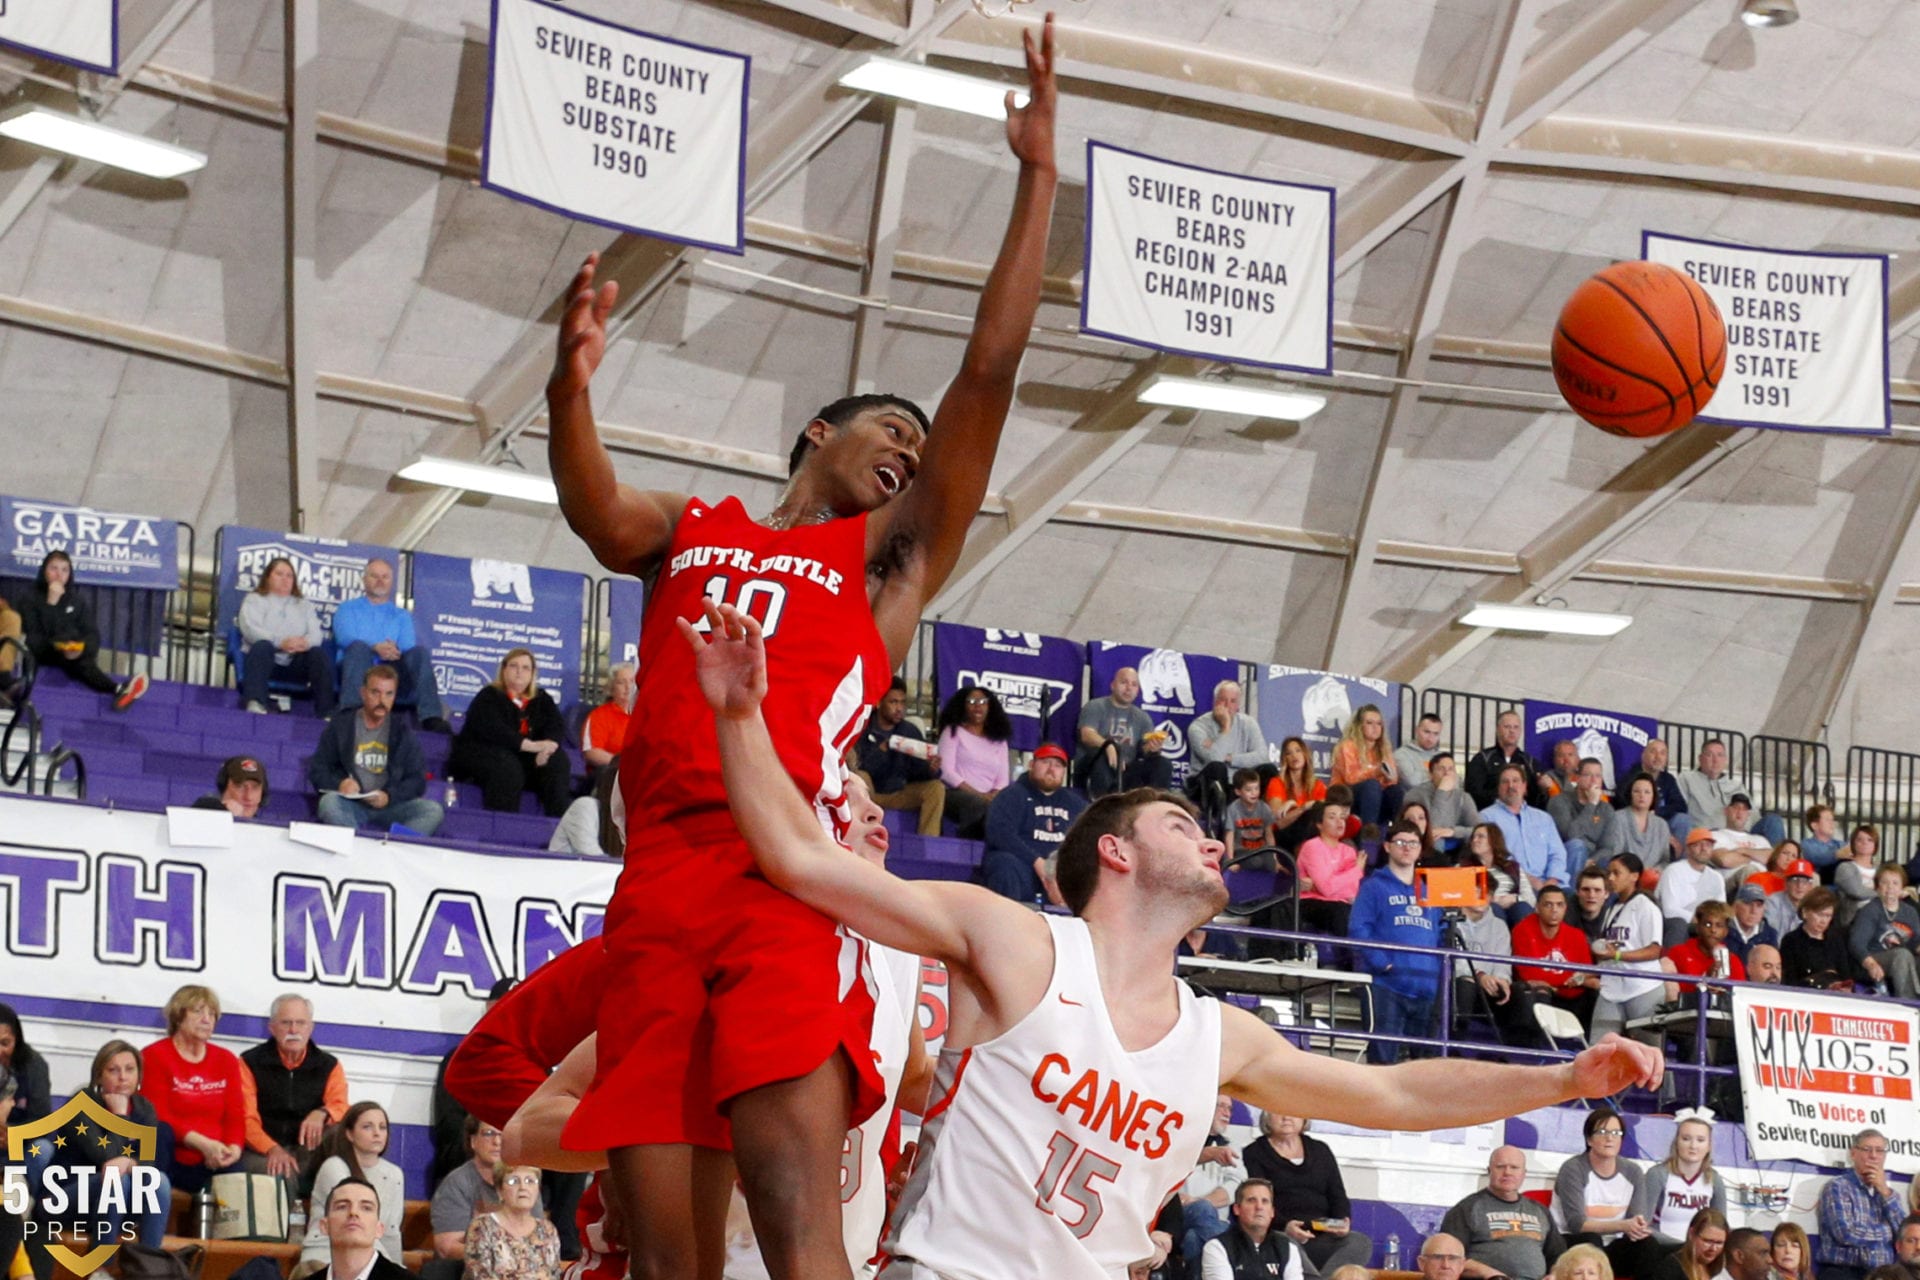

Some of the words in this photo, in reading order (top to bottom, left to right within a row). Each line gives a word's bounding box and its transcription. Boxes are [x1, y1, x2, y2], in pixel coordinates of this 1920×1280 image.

[536, 26, 612, 71] SEVIER
[622, 53, 709, 95] COUNTY
[585, 75, 657, 115] BEARS
[562, 101, 677, 153] SUBSTATE
[593, 143, 647, 179] 1990
[1128, 175, 1201, 211] SEVIER
[1212, 193, 1295, 227] COUNTY
[1176, 216, 1246, 250] BEARS
[1135, 237, 1215, 275] REGION
[1226, 256, 1288, 286] 2-AAA
[1684, 260, 1756, 290] SEVIER
[1767, 271, 1850, 297] COUNTY
[1145, 271, 1275, 314] CHAMPIONS
[1732, 296, 1801, 323] BEARS
[1185, 309, 1233, 338] 1991
[1728, 324, 1821, 353] UBSTATE
[1735, 354, 1798, 379] STATE
[1743, 383, 1790, 408] 1991
[14, 509, 159, 547] GARZA
[16, 535, 68, 551] LAW
[75, 541, 130, 561] FIRM
[690, 574, 787, 640] 10
[1535, 712, 1573, 734] SEVIER
[1574, 713, 1619, 734] COUNTY
[1620, 721, 1648, 748] HIGH
[1749, 1006, 1815, 1094] MIX
[1830, 1016, 1895, 1041] TENNESSEE'S
[1815, 1038, 1910, 1077] 105.5
[1031, 1053, 1184, 1159] CANES
[1787, 1099, 1816, 1119] The
[1818, 1102, 1866, 1123] Voice
[1870, 1108, 1886, 1125] of
[1758, 1122, 1807, 1143] Sevier
[1034, 1130, 1122, 1239] 15
